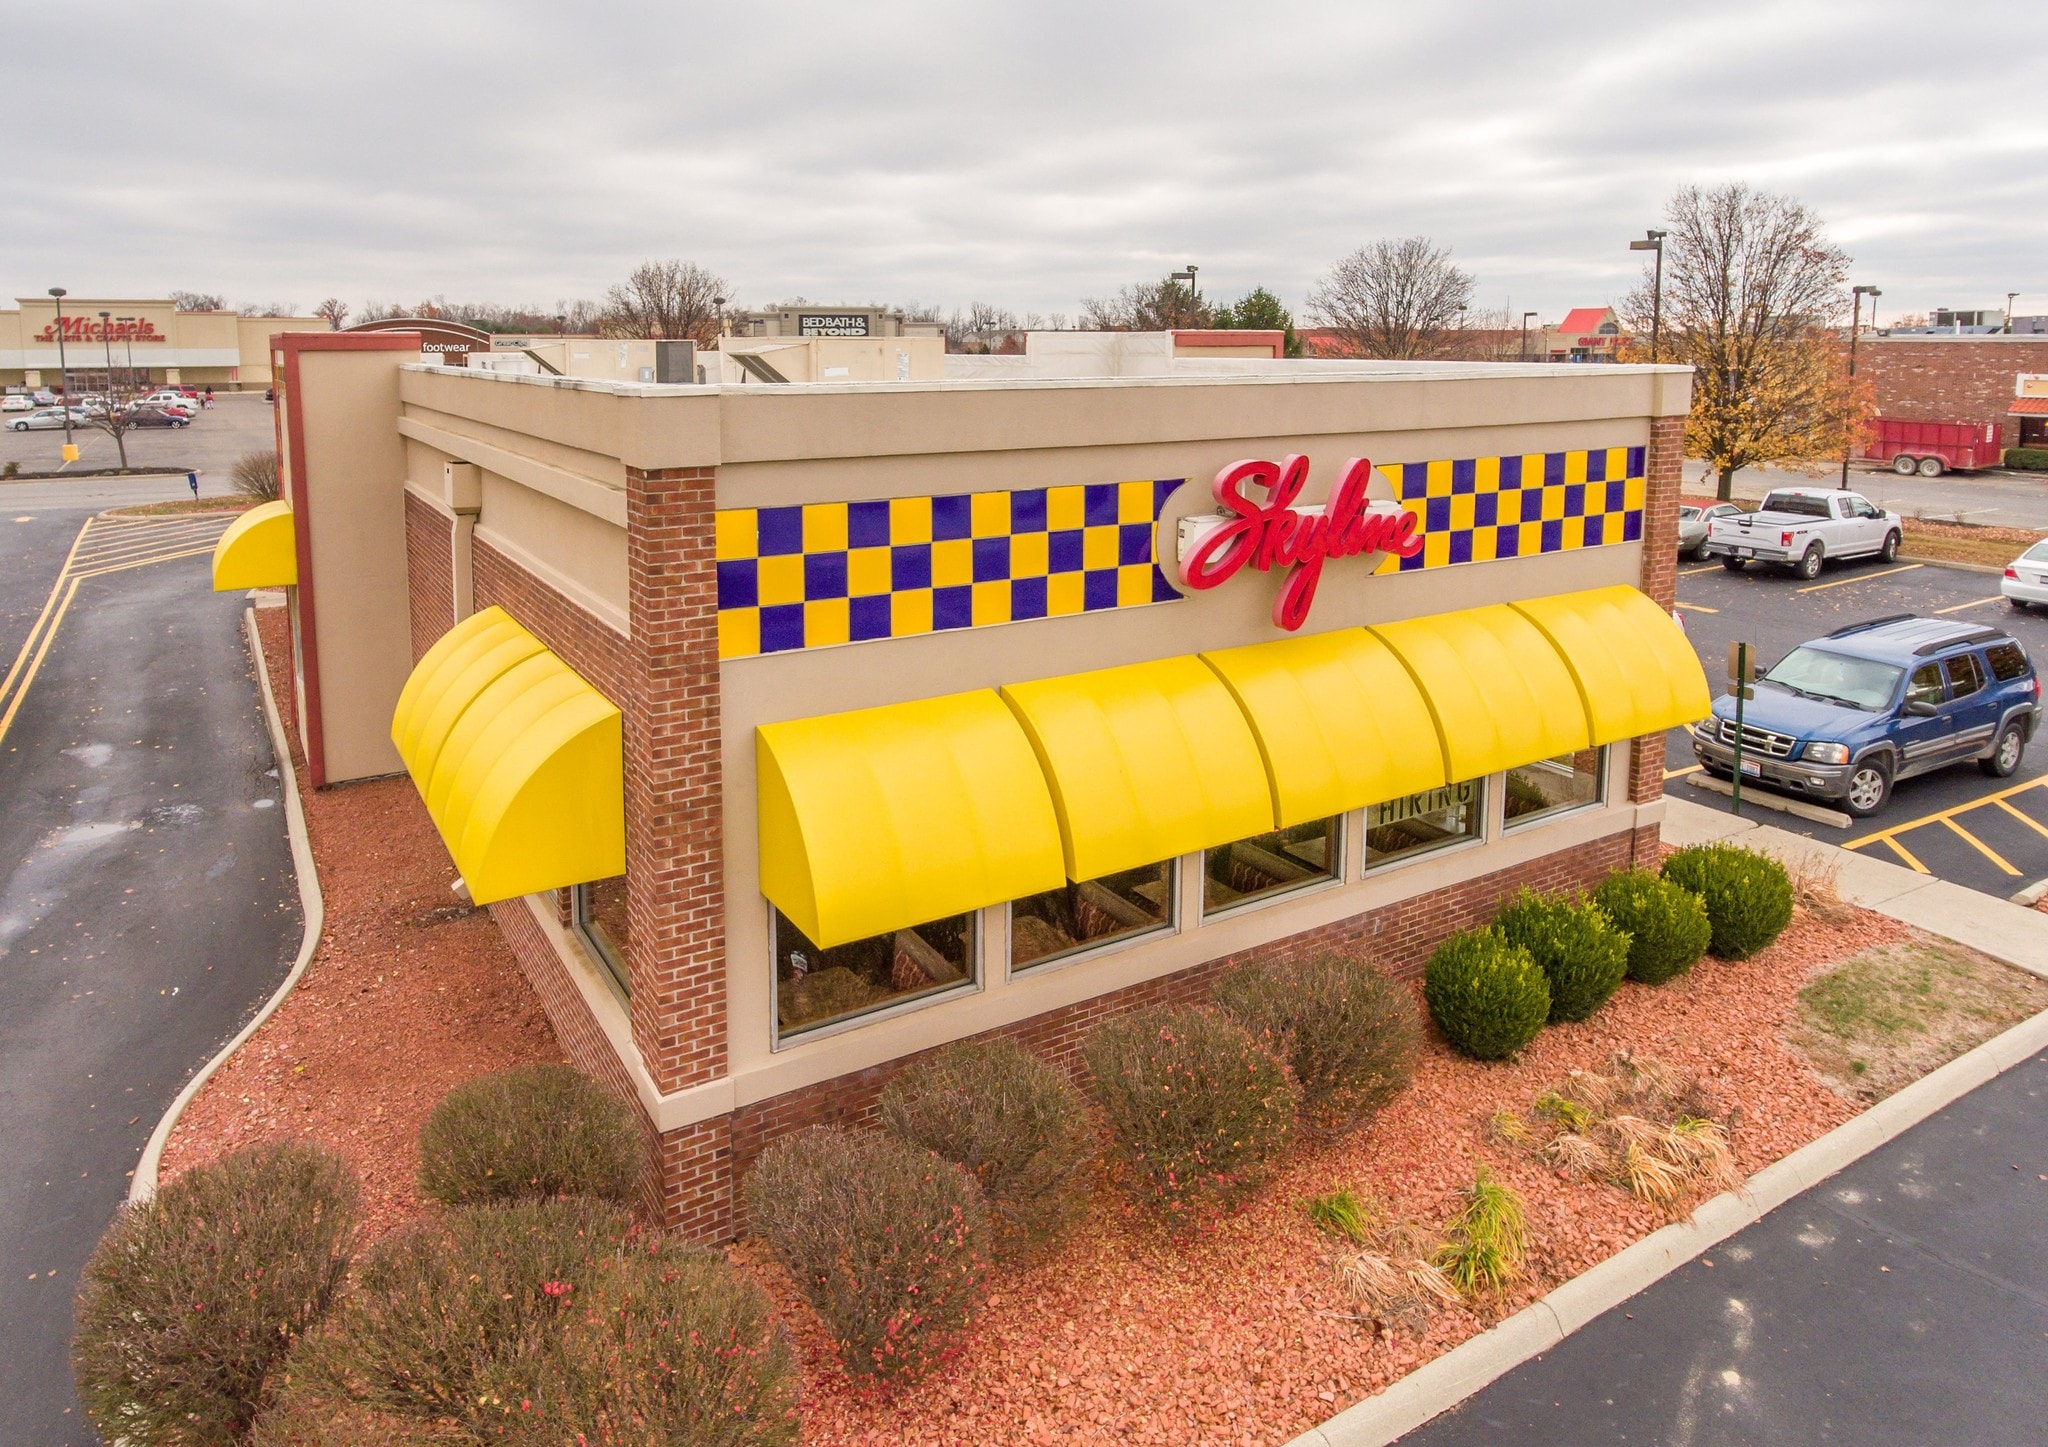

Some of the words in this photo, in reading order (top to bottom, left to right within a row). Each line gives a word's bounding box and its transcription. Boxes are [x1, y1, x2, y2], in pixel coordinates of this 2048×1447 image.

[44, 316, 155, 335] Michaels
[803, 317, 825, 327] BED
[825, 317, 855, 327] BATH
[855, 317, 866, 327] &
[802, 328, 867, 336] BEYOND
[34, 335, 54, 343] THE
[135, 335, 166, 343] STORE
[423, 342, 470, 352] footwear
[1178, 454, 1425, 631] Skyline
